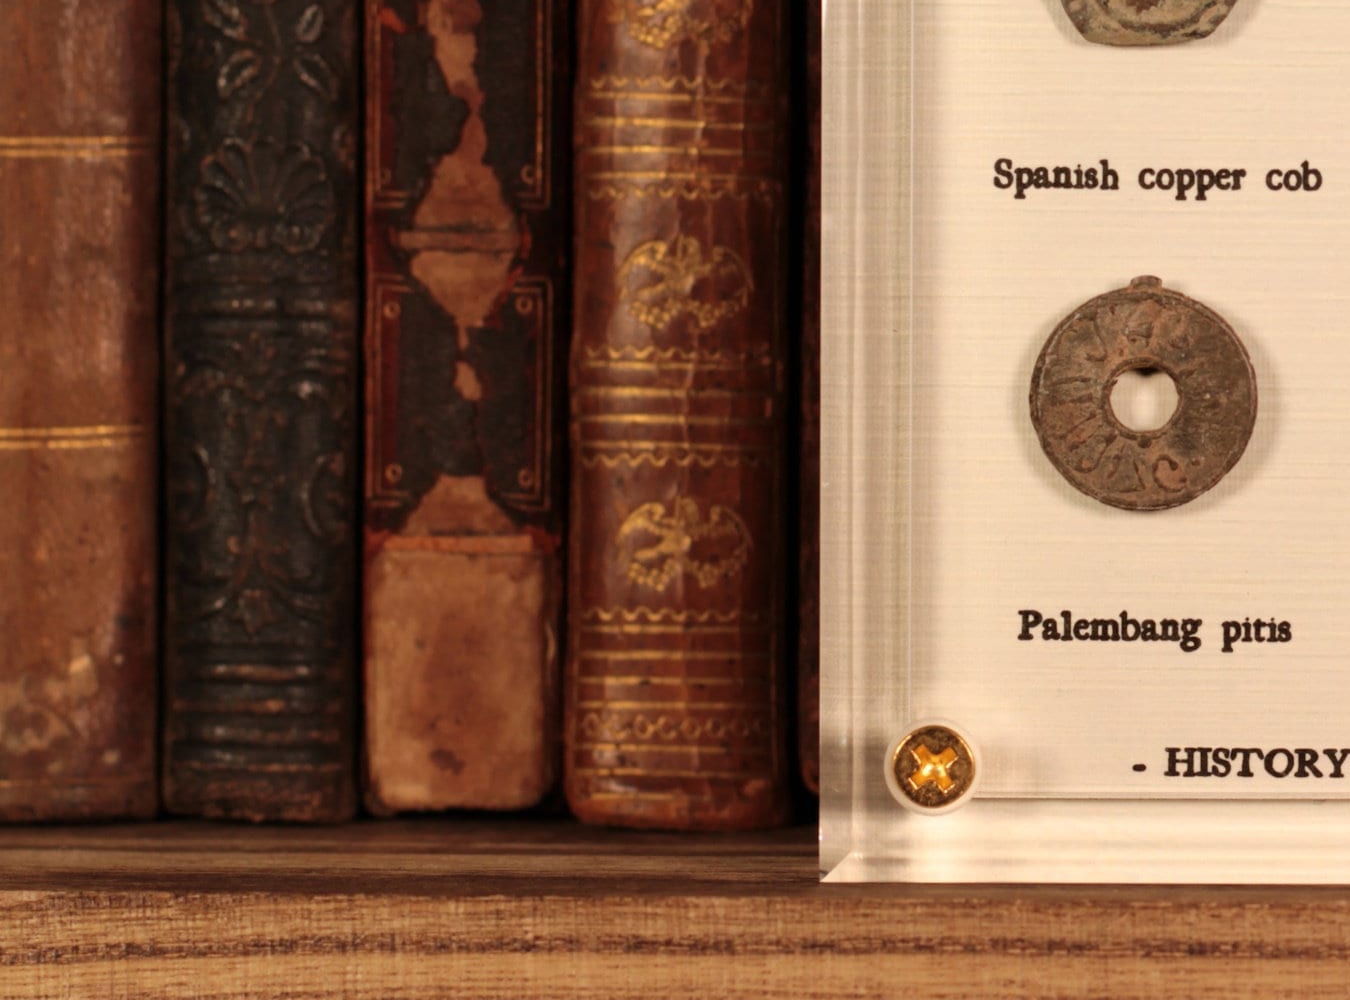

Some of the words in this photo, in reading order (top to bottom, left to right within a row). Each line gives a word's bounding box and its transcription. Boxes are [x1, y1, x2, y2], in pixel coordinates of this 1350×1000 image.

[993, 158, 1120, 201] Spanish
[1137, 167, 1247, 201] copper
[1265, 160, 1323, 193] cob
[1017, 609, 1203, 653] Palembang
[1221, 614, 1293, 653] pitis
[1132, 763, 1147, 773] -
